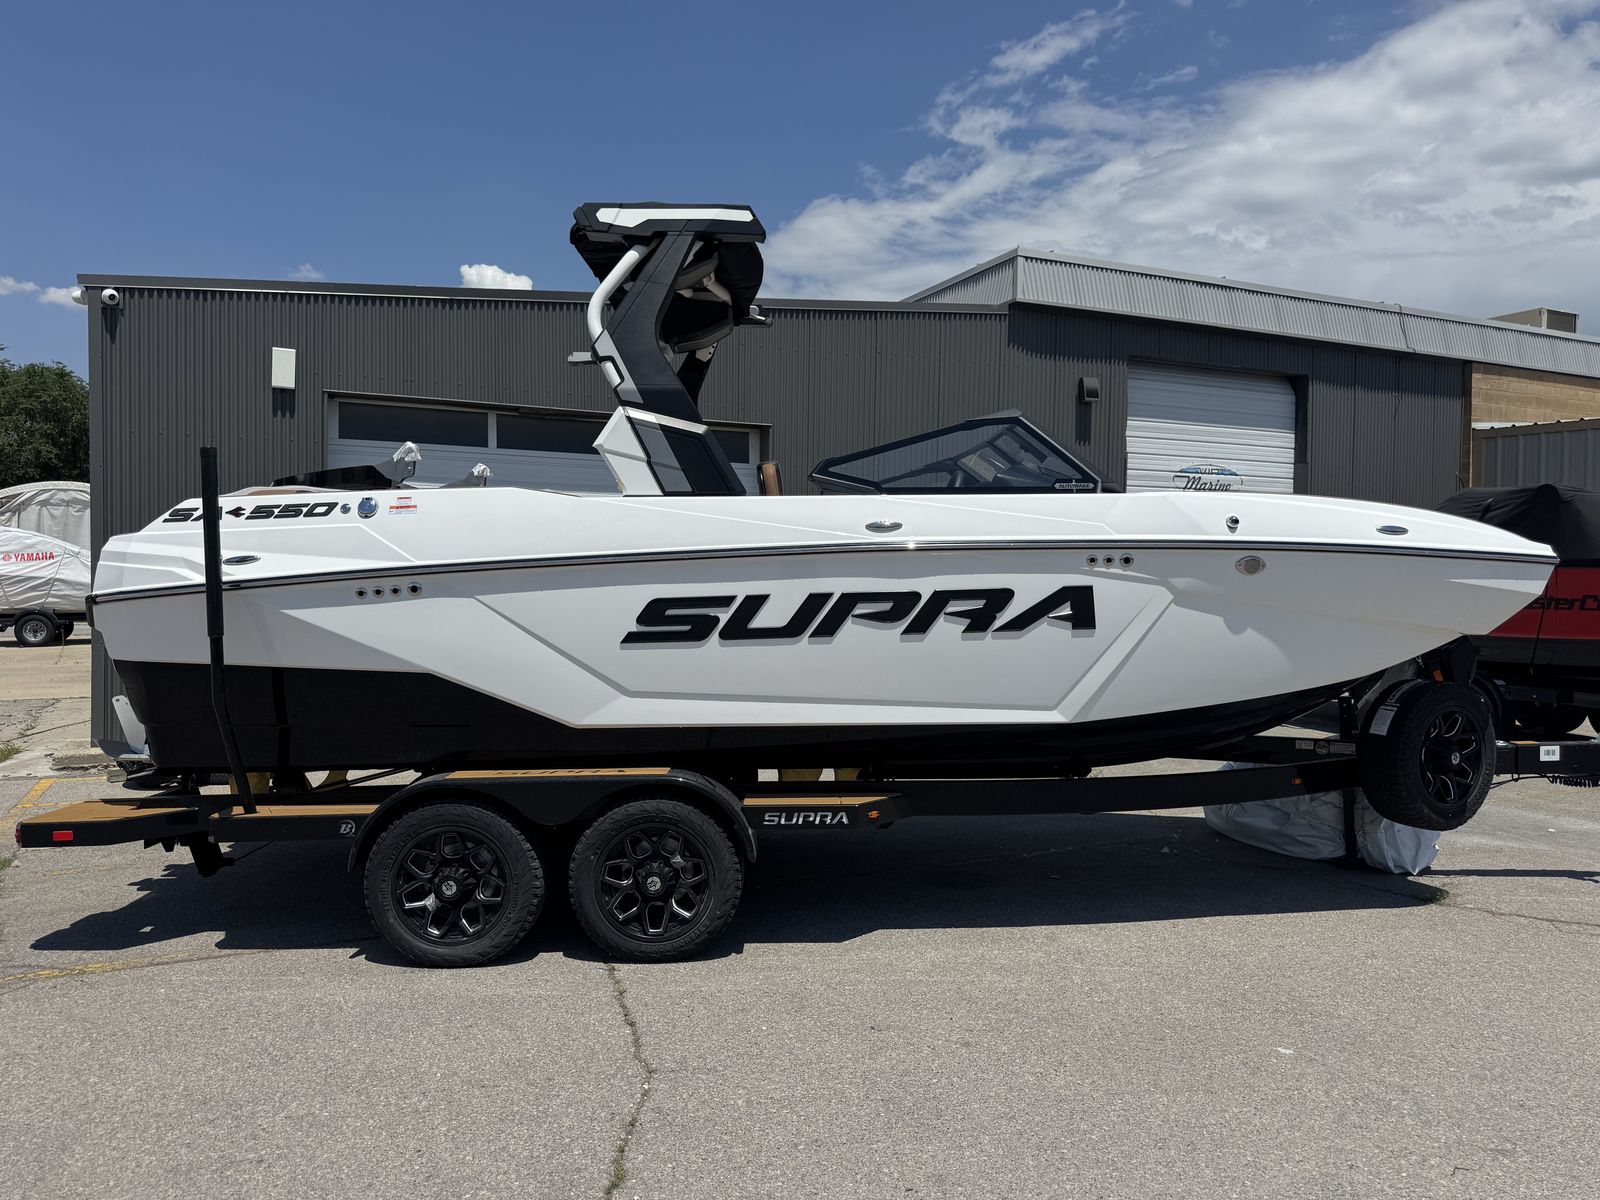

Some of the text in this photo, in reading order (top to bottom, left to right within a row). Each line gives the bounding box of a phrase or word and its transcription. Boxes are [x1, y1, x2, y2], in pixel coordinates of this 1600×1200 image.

[1174, 474, 1232, 491] Marine
[245, 501, 339, 521] 550
[14, 552, 54, 561] YAMAHA
[620, 585, 1096, 646] SUPRA
[763, 811, 849, 825] SUPRA
